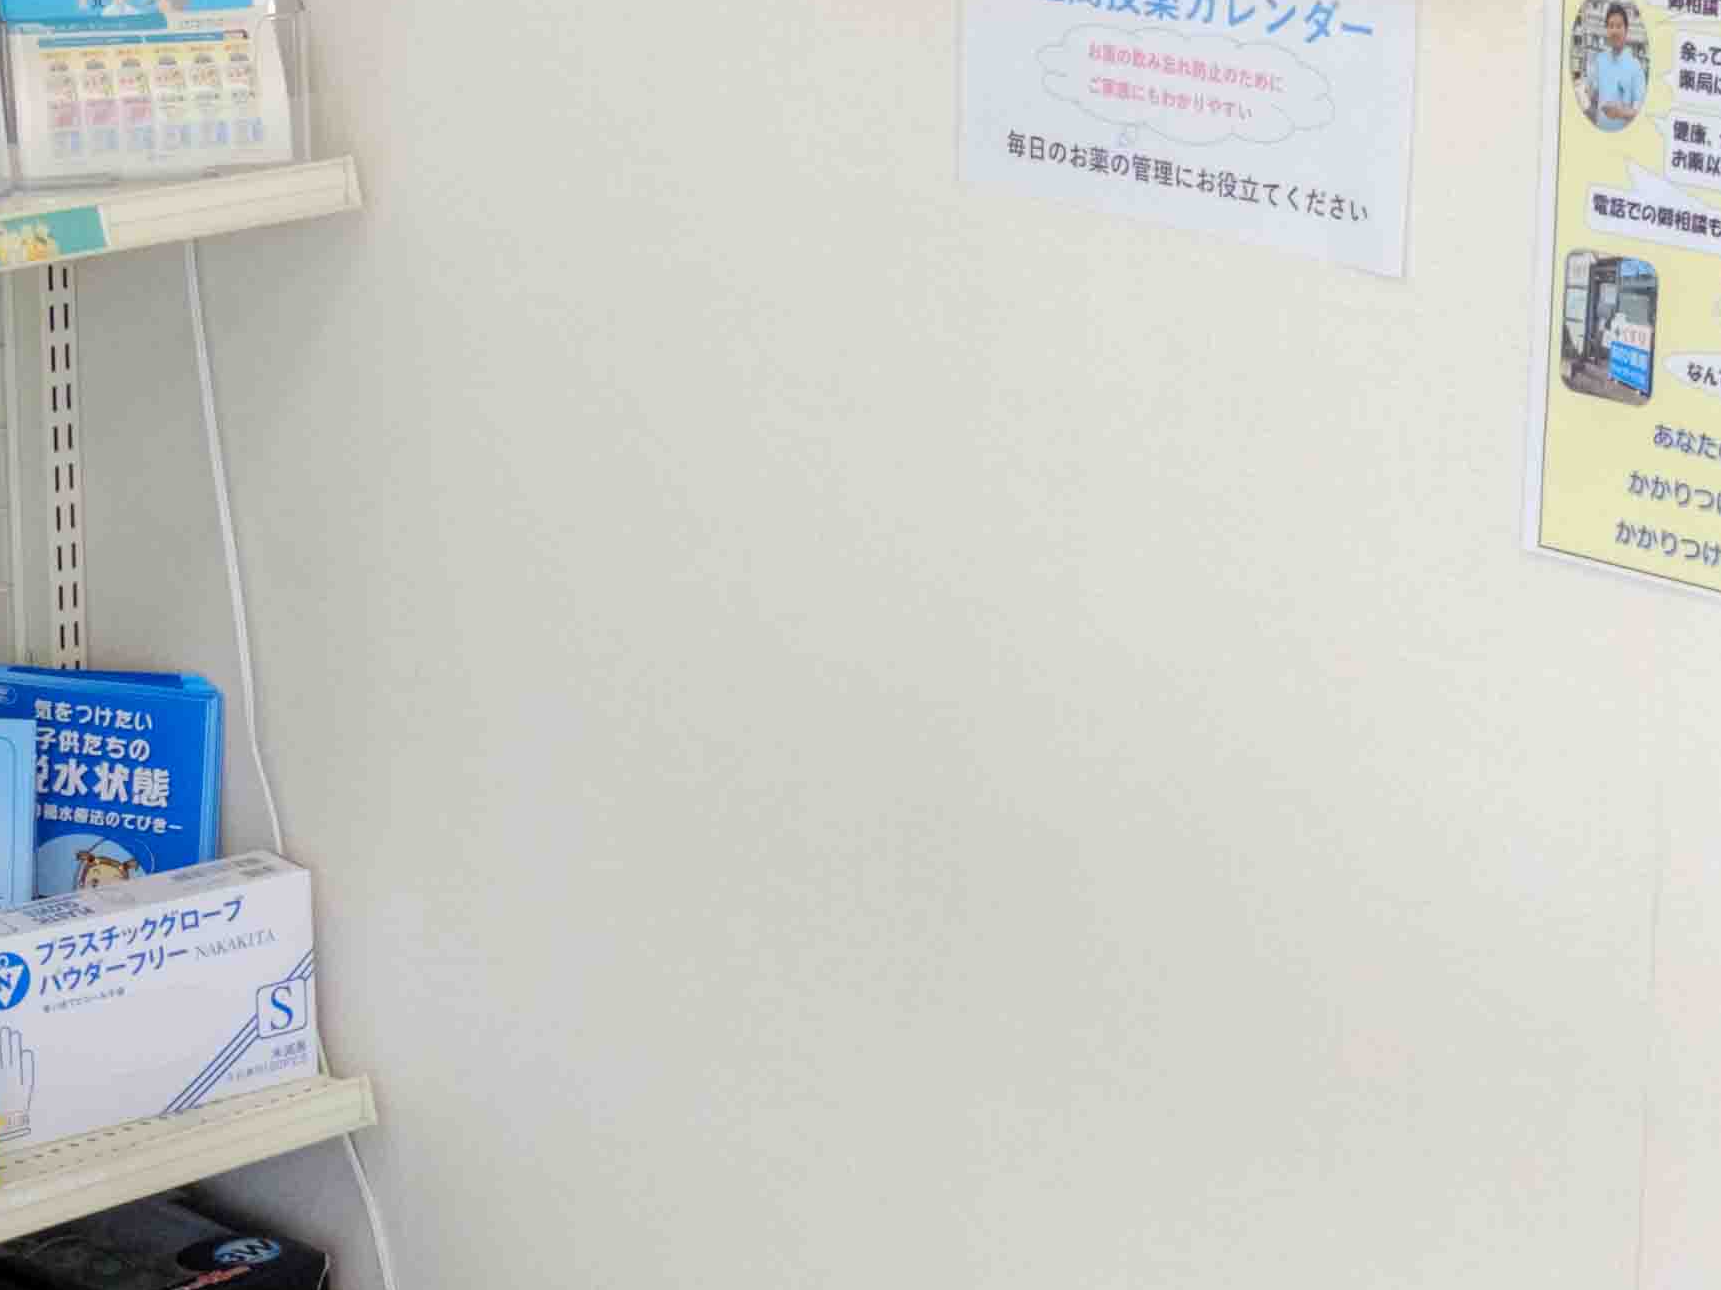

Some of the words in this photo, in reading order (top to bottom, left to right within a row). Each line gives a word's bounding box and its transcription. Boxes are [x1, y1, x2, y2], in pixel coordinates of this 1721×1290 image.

[1086, 41, 1286, 95] お薬の飲み忘れ防止のために
[1086, 75, 1254, 123] ご家族にもわかりやすい
[1005, 129, 1370, 224] 毎日のお薬の管理にお役立てください
[34, 697, 154, 732] 気をつけたい
[36, 725, 153, 762] 子供たちの
[35, 894, 245, 966] プラスチックグローブ
[193, 930, 278, 961] NAKAKITA
[37, 944, 190, 998] パウダーフリー
[262, 984, 295, 1031] S
